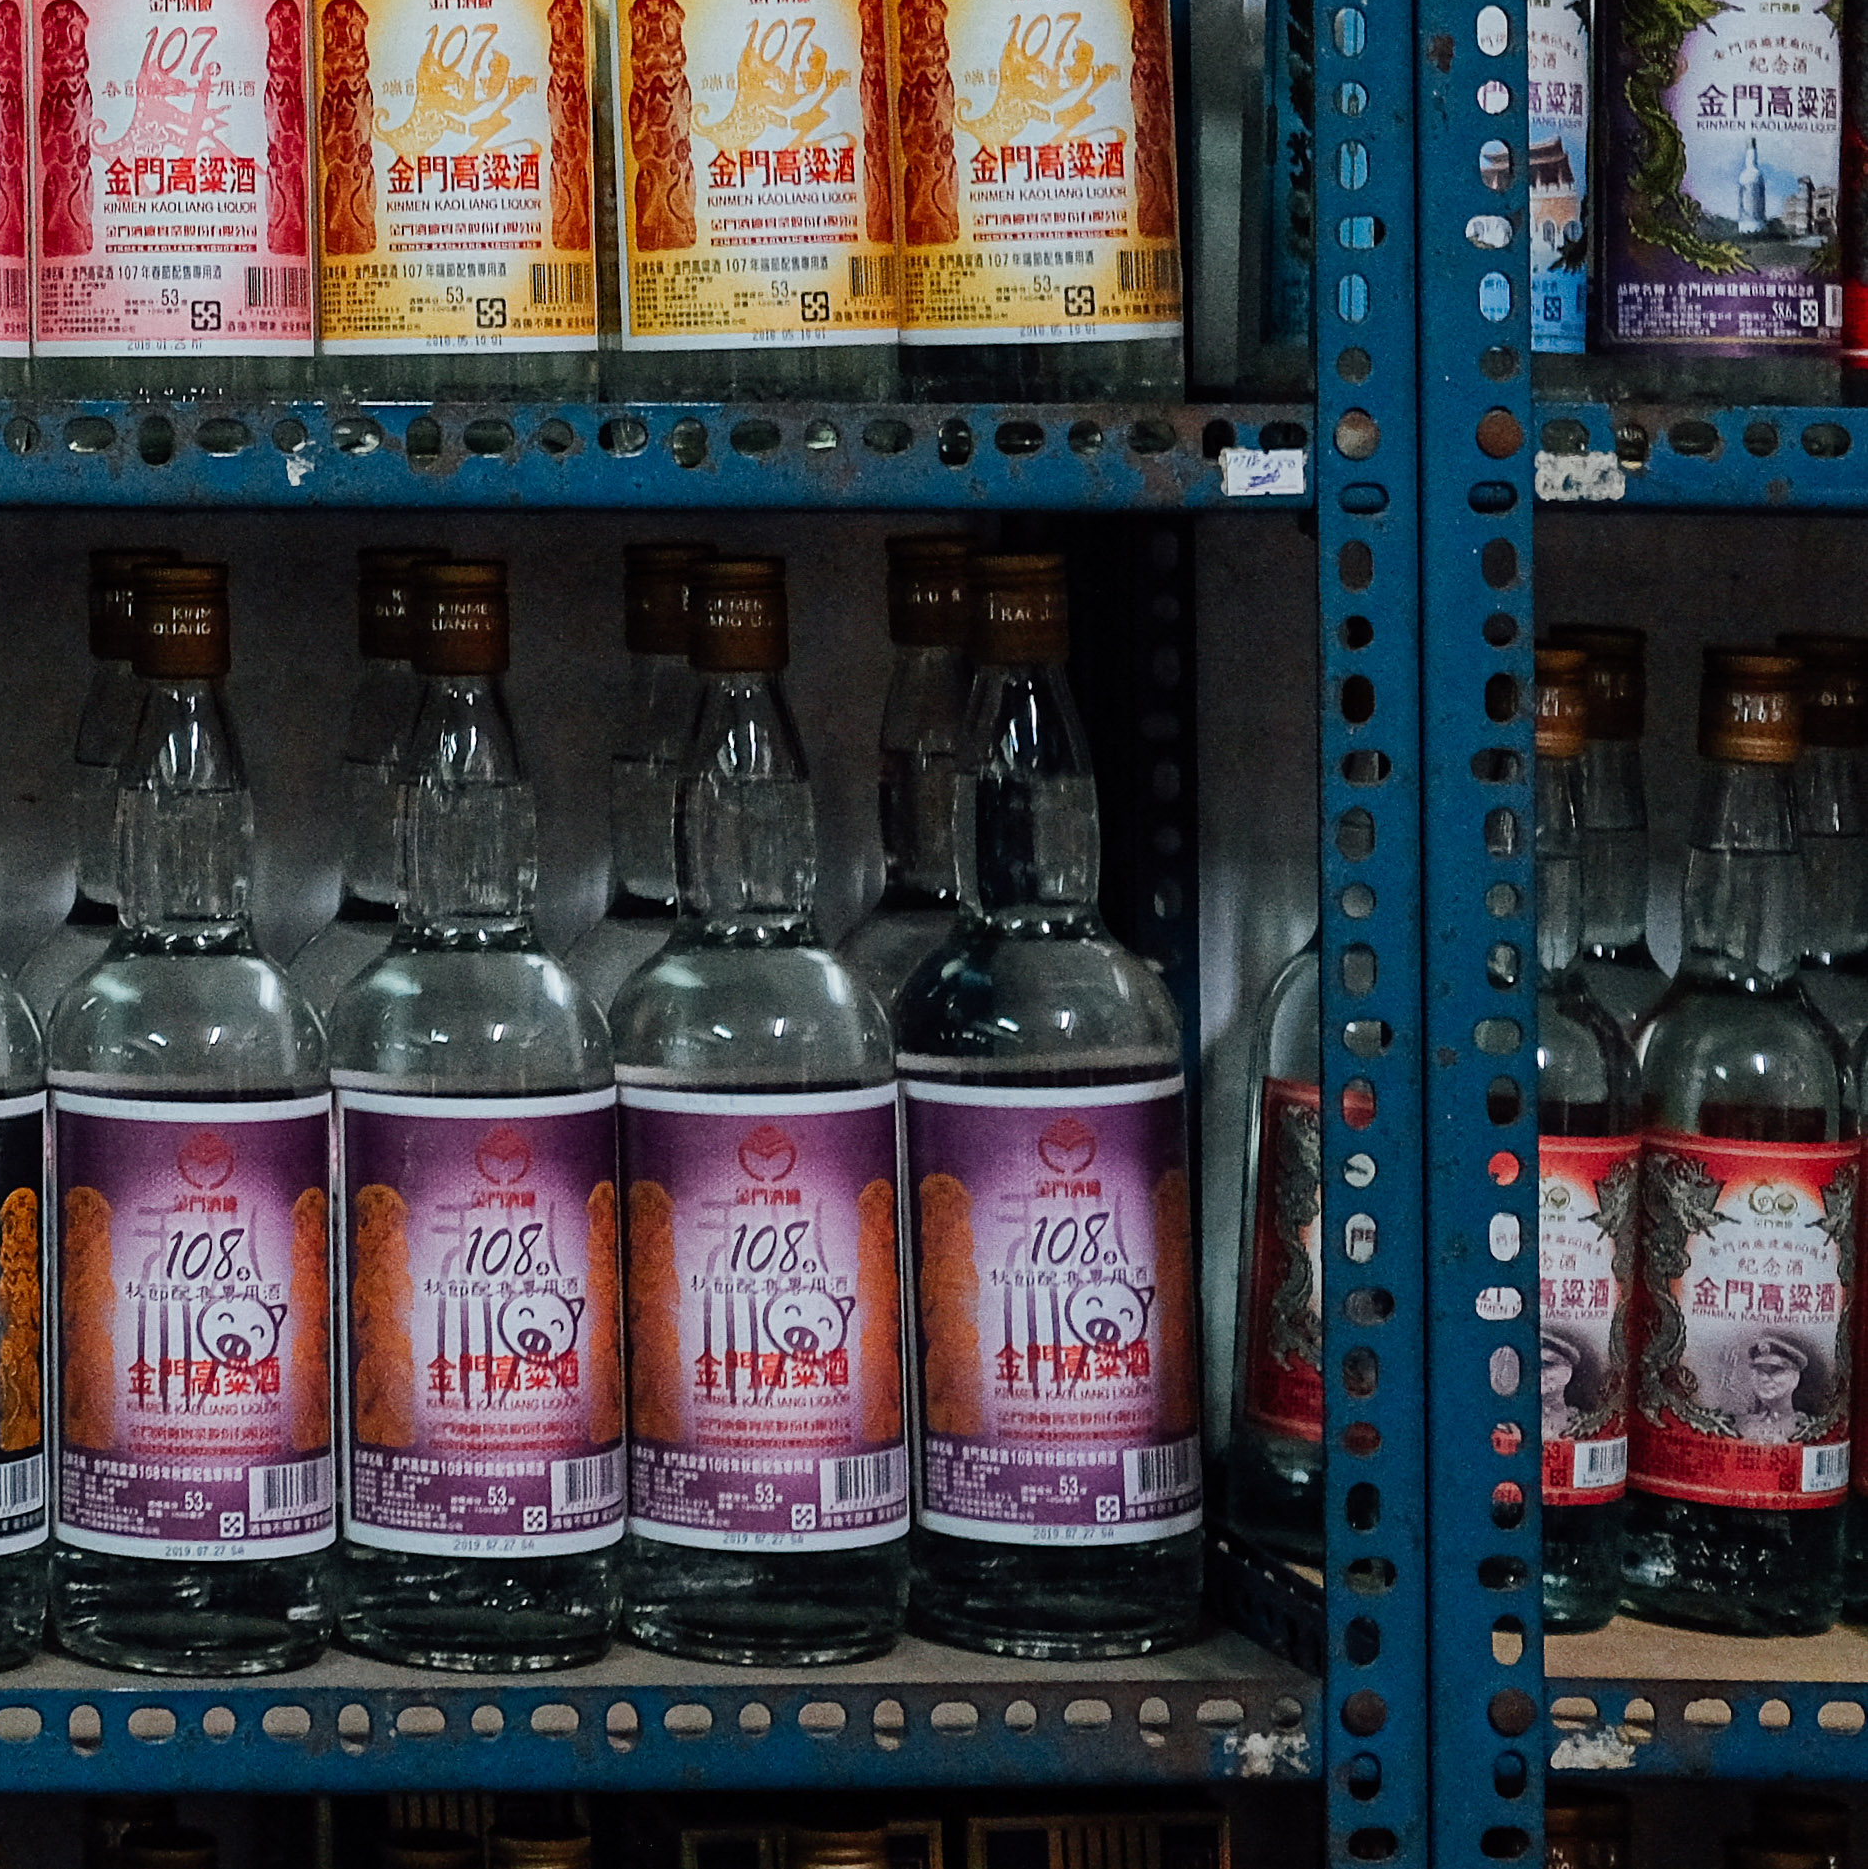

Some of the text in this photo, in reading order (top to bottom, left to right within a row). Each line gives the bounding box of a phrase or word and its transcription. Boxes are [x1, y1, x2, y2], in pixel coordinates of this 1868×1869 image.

[104, 158, 256, 196] 金門高粱酒
[387, 152, 539, 192] 金門高粱酒
[708, 150, 857, 189] 金門高粱酒
[970, 143, 1123, 184] 金門高粱酒
[103, 202, 257, 215] KINMEN KAOLIANG LIQUOR
